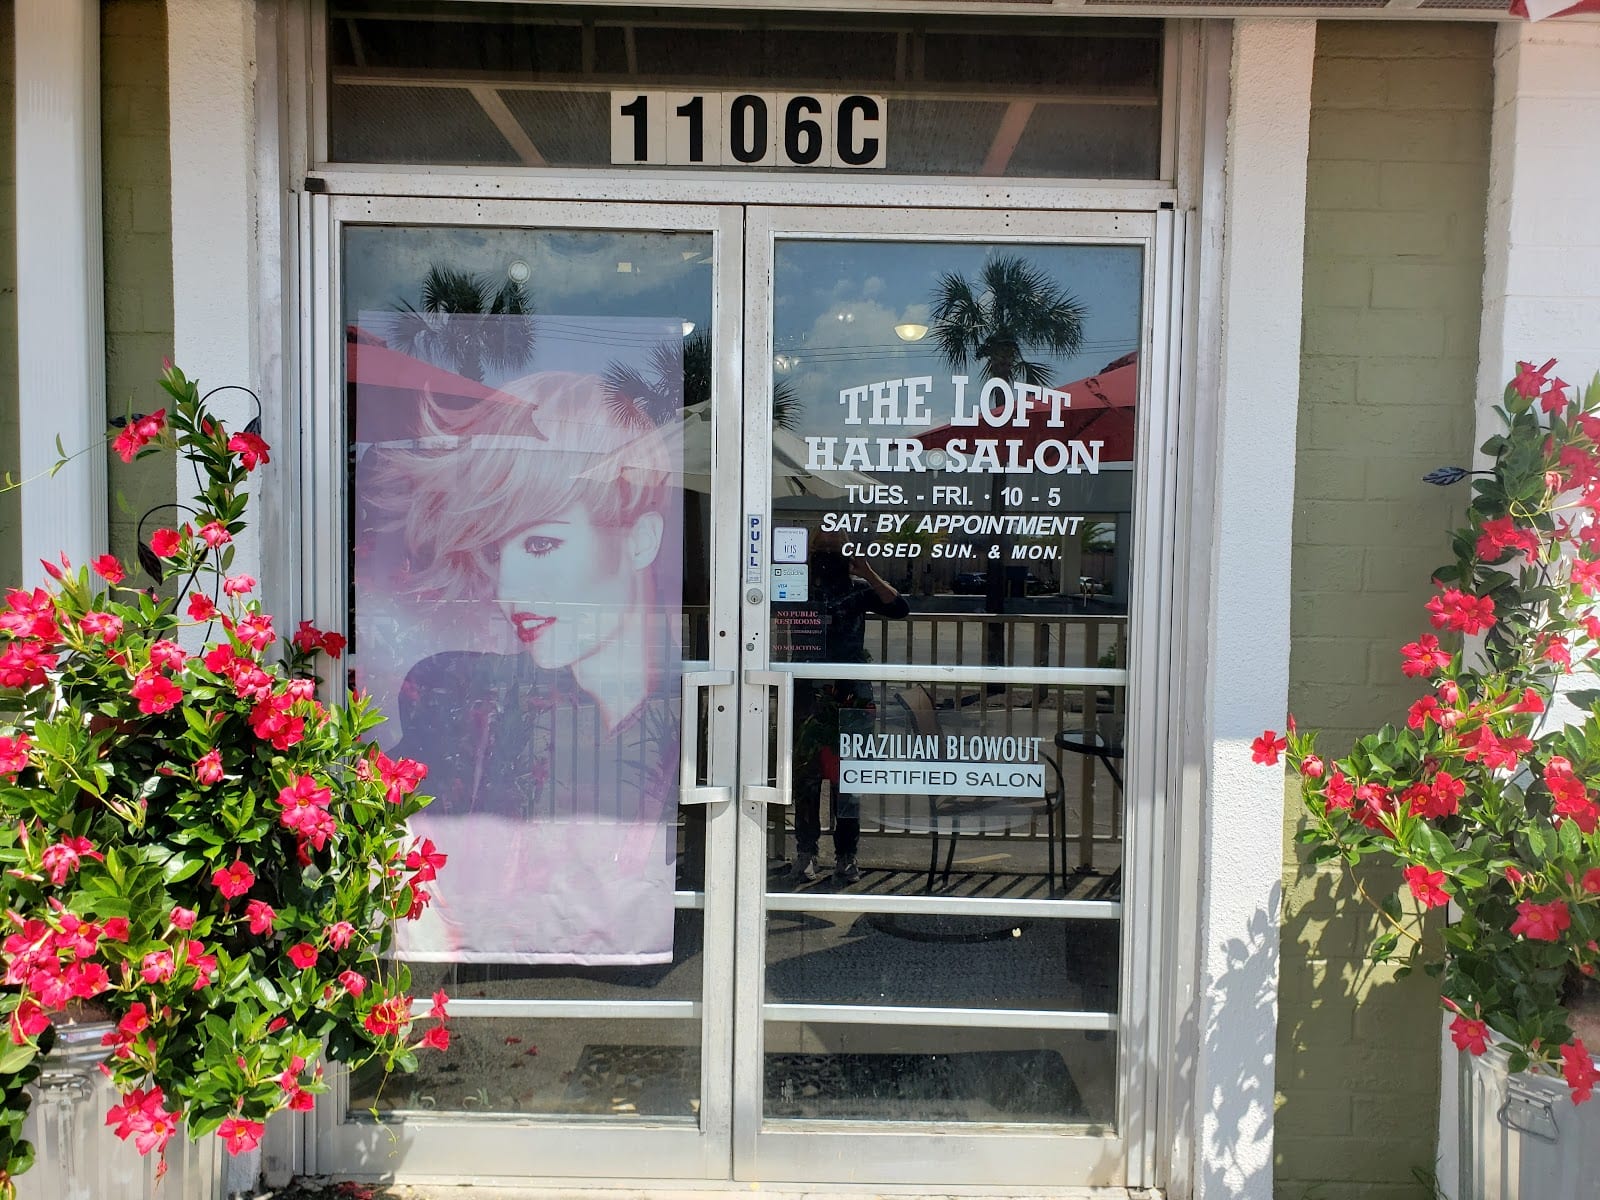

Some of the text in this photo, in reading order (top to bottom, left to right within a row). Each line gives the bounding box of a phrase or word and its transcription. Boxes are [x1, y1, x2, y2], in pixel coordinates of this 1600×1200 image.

[620, 94, 880, 166] 1106C
[839, 375, 1071, 428] THE LOFT
[804, 436, 1105, 475] HAIR SALON
[844, 484, 909, 505] TUES.
[932, 486, 974, 506] FRI.
[1000, 487, 1024, 507] 10
[1048, 487, 1061, 507] 5
[820, 513, 1085, 536] SAT. BY APPOINTMENT
[750, 518, 760, 567] PULL
[841, 542, 1063, 560] CLOSED SUN. & MON.
[840, 733, 1043, 762] BRAZILIAN BLOWOUT
[843, 769, 1043, 788] CERTIFIED SALON
